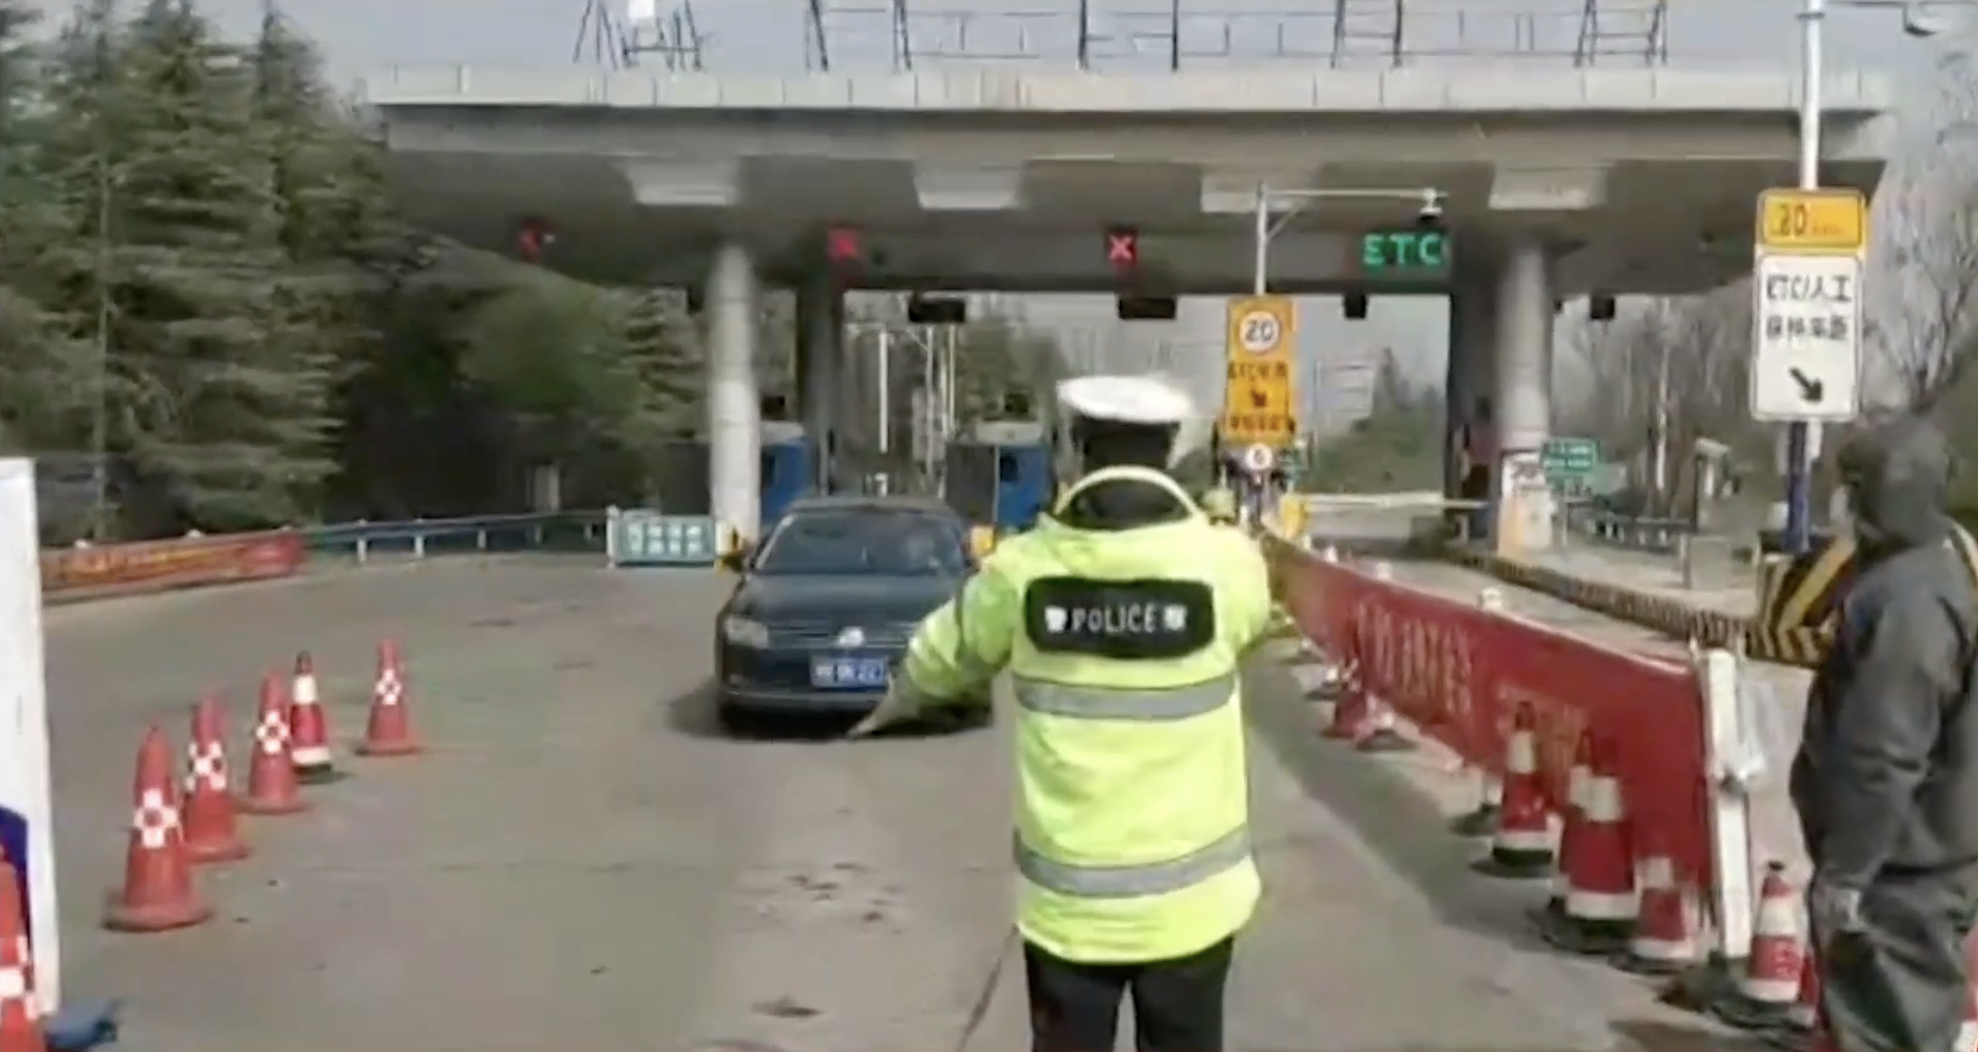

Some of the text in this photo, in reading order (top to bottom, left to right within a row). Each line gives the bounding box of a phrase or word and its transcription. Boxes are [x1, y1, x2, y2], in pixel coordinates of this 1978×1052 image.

[1364, 232, 1441, 265] ETC
[1245, 320, 1274, 342] 20
[1071, 604, 1157, 634] POLICE
